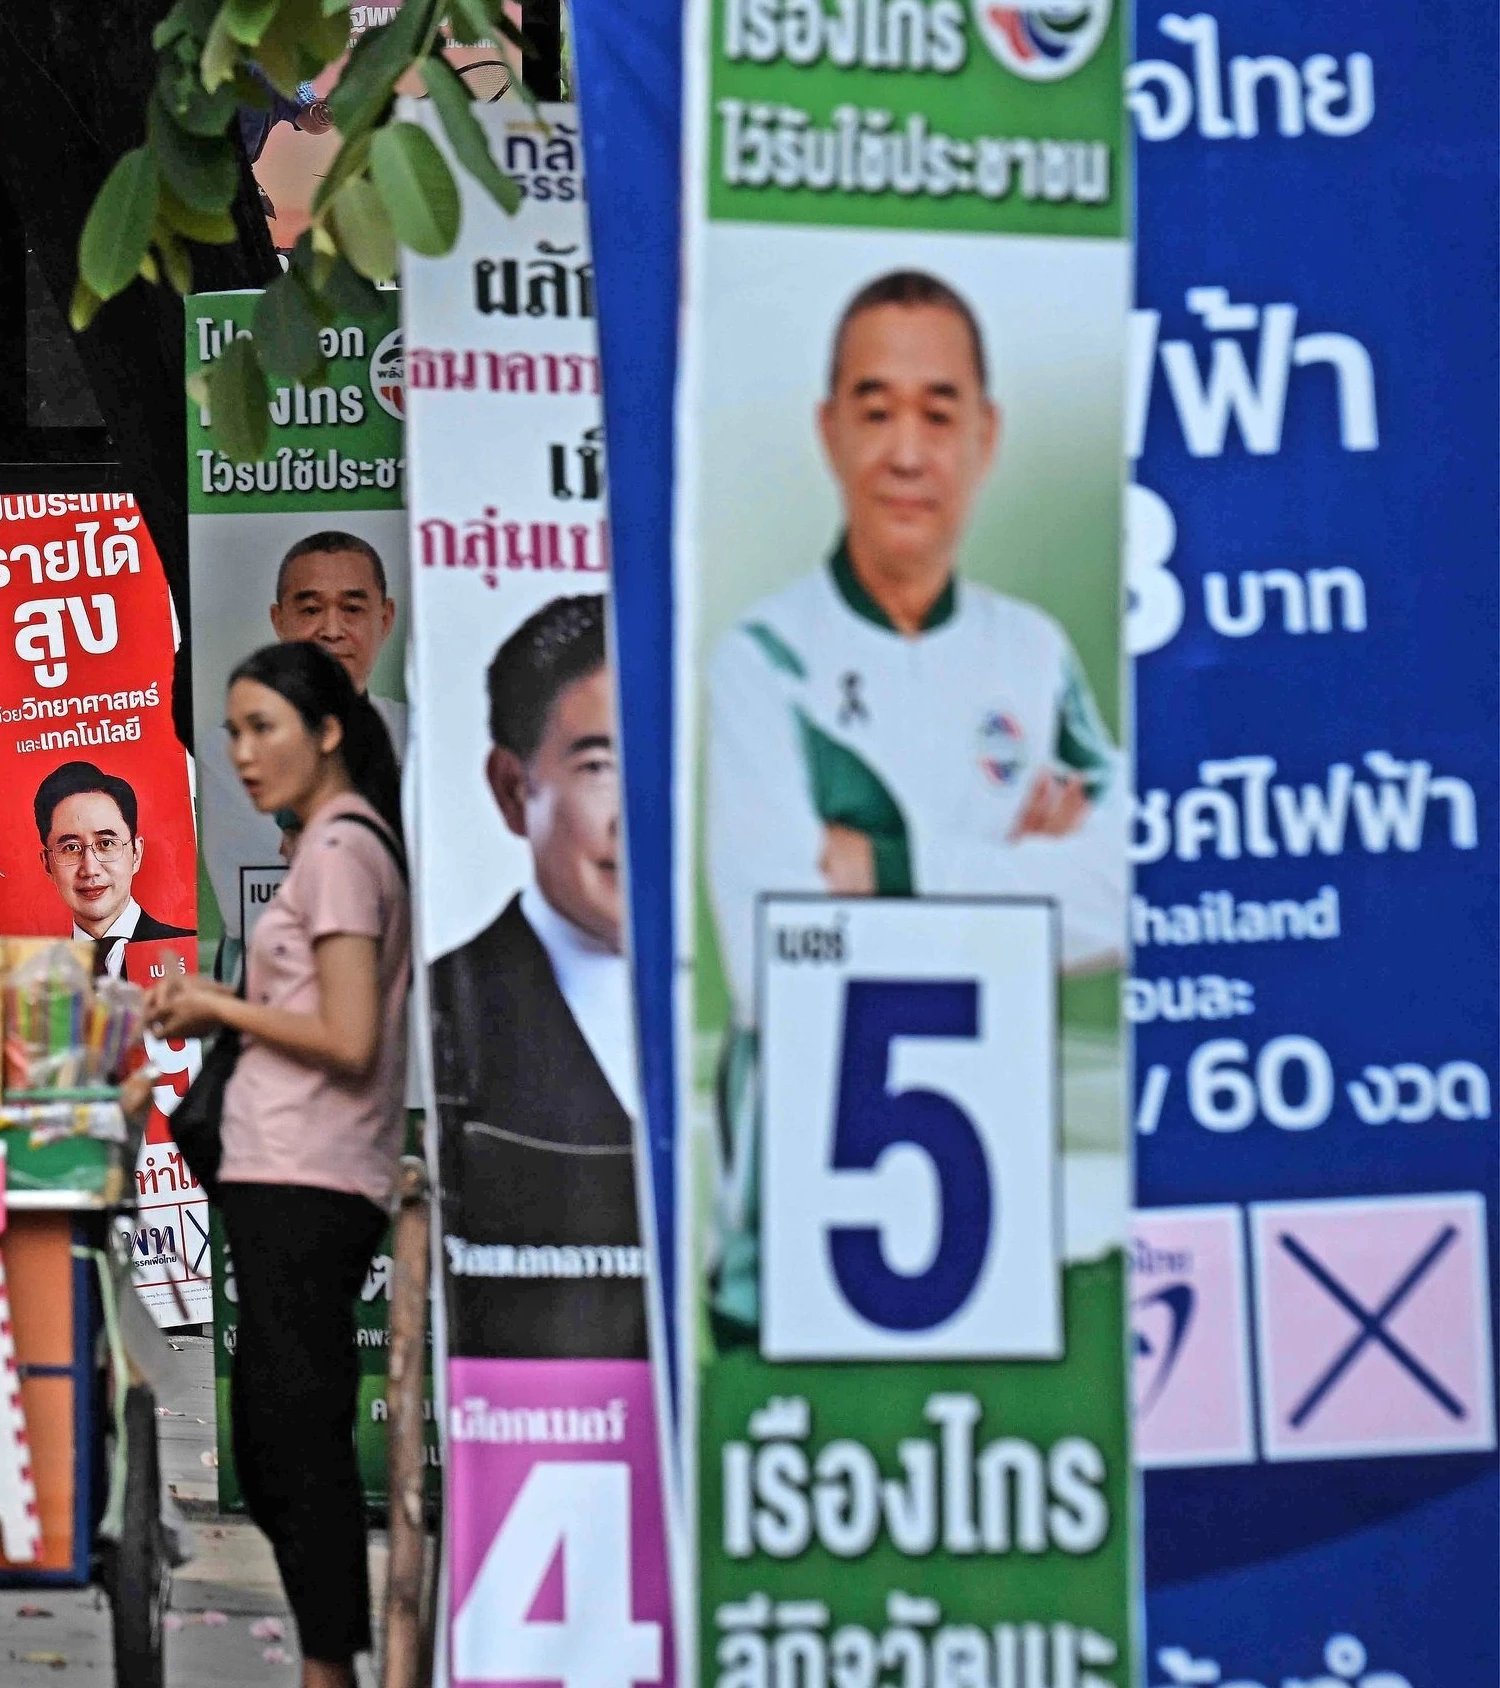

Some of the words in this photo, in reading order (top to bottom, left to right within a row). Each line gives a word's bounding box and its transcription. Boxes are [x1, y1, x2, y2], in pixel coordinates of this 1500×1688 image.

[13, 592, 120, 689] สูง
[1203, 565, 1369, 638] บาท
[16, 715, 143, 754] และเทคโนโลยี
[1187, 1034, 1336, 1133] 60
[1346, 1060, 1492, 1126] งวด
[823, 977, 996, 1336] 5
[452, 1460, 664, 1688] 4
